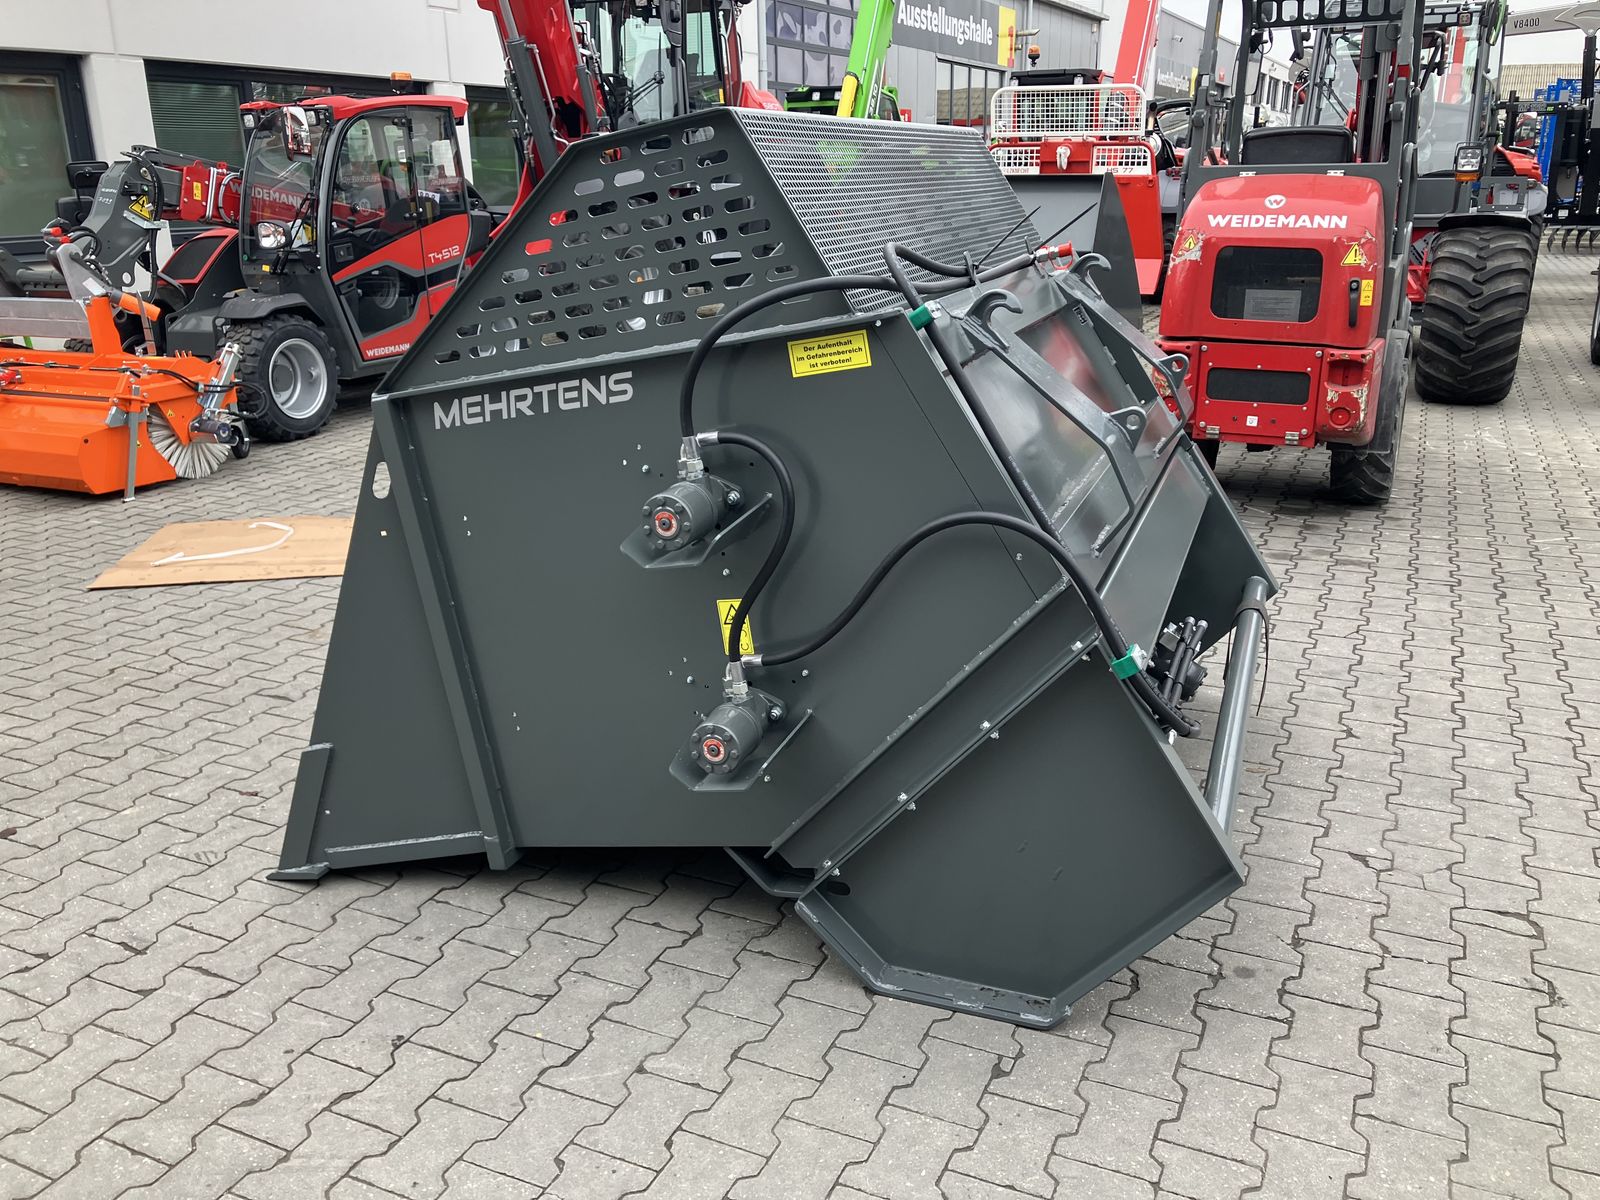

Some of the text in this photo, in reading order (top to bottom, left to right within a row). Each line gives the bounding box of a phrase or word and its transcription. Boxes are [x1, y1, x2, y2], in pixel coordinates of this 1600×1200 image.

[897, 0, 992, 45] Ausstellungshalle
[1513, 18, 1540, 29] V8400
[1208, 214, 1347, 229] WEIDEMANN
[428, 245, 461, 263] T4512
[366, 343, 410, 357] WEIDEMANN
[817, 339, 852, 350] Aufenthalt
[806, 346, 863, 360] Gefahrenbereich
[820, 357, 852, 367] verboten!
[433, 370, 634, 430] MEHRTENS
